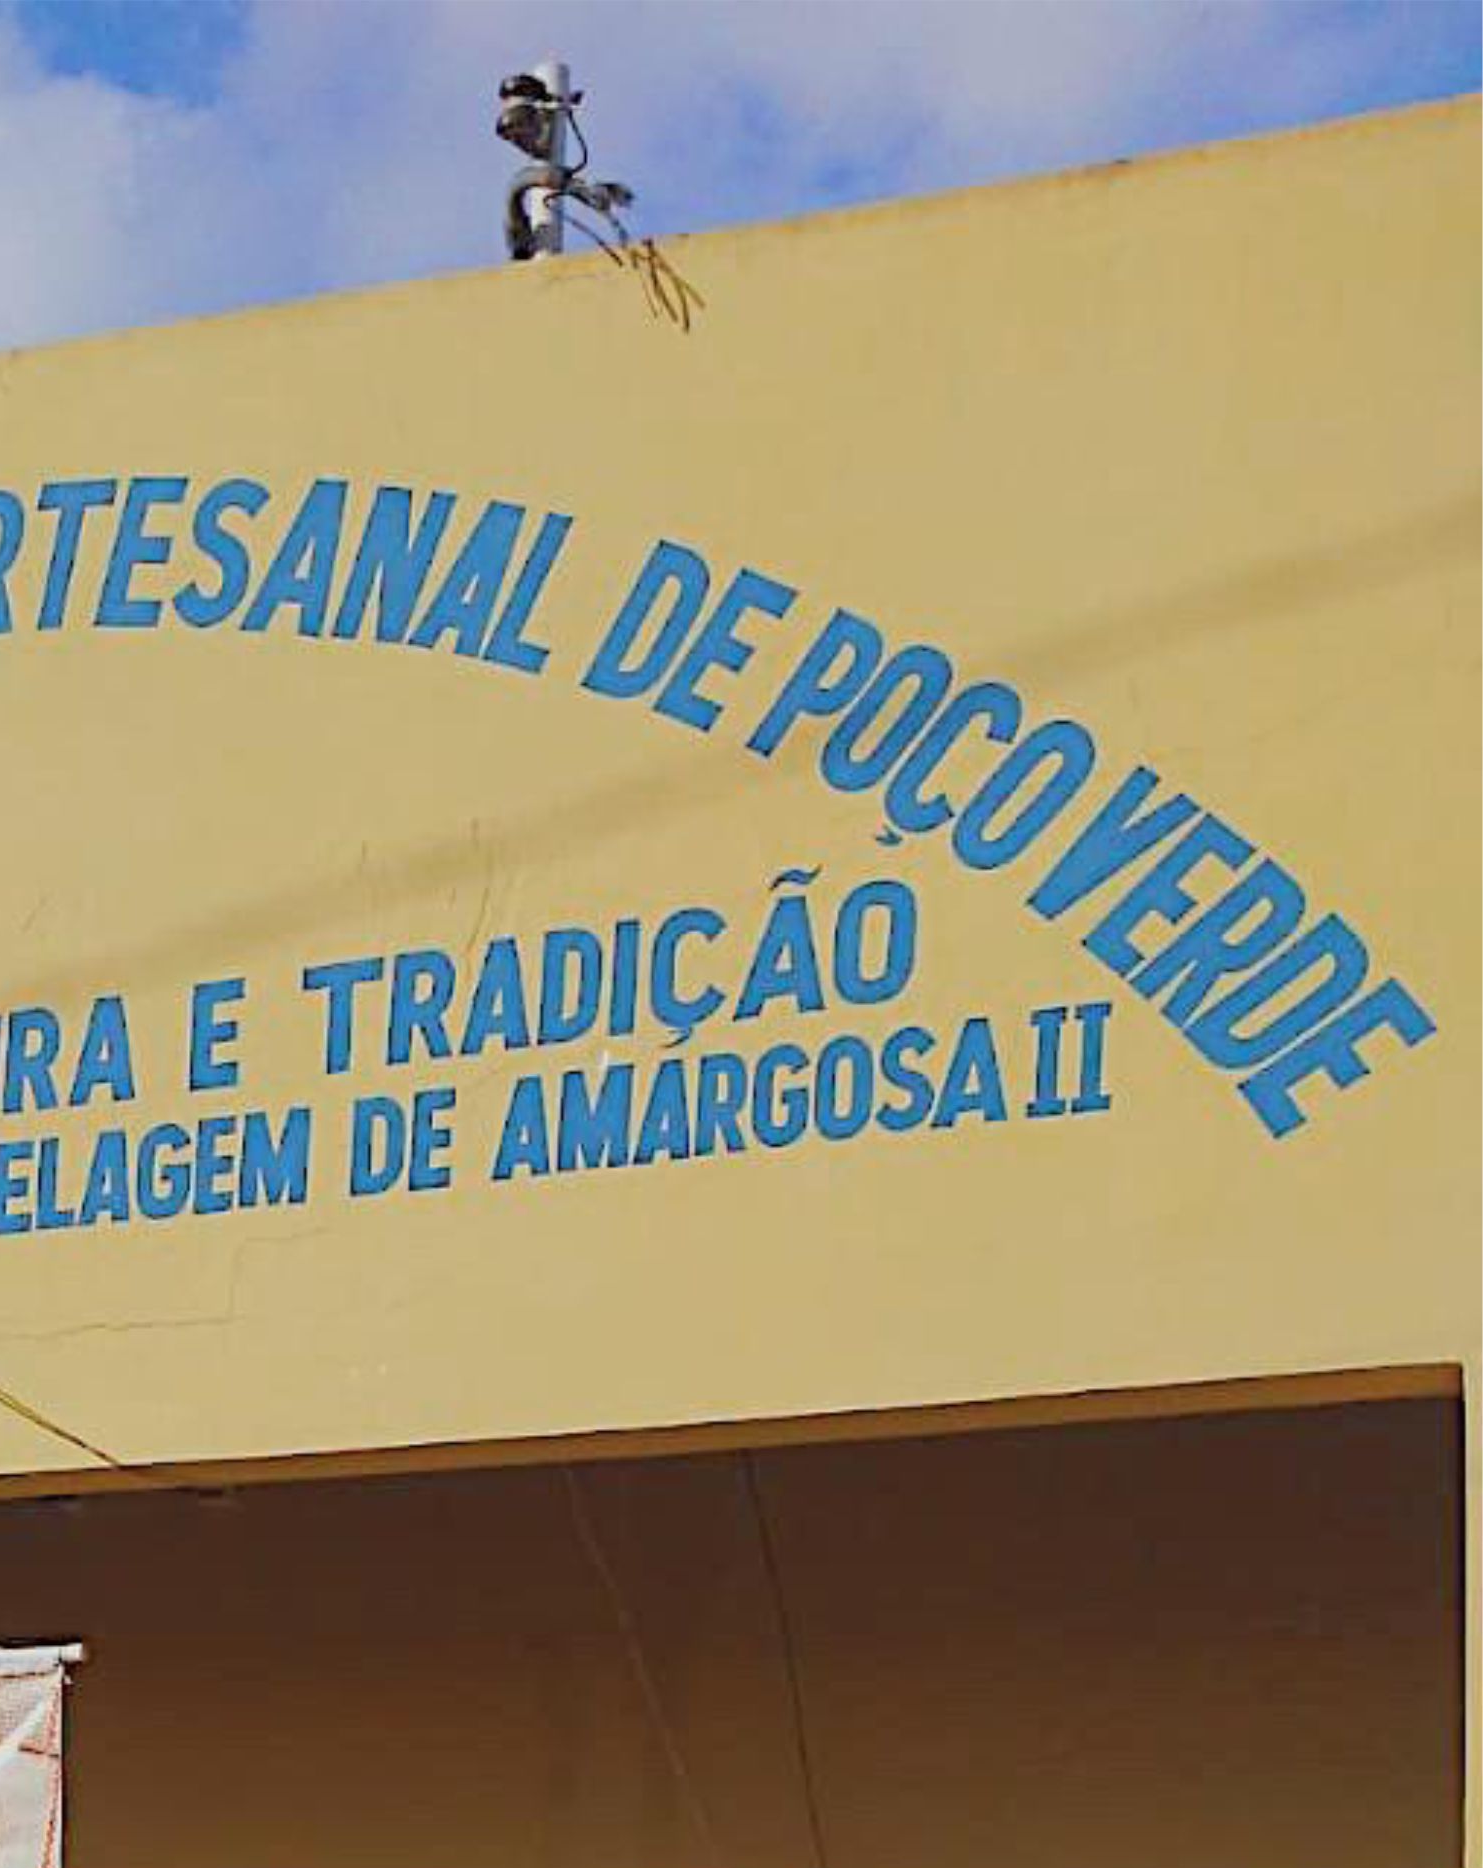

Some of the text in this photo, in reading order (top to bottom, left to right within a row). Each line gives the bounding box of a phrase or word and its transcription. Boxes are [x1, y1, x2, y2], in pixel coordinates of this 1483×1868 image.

[583, 540, 796, 732] DE
[746, 608, 1097, 872] POÇO
[1026, 766, 1437, 1140] VERDE
[187, 978, 246, 1091] E
[301, 866, 917, 1075] TRADIÇÃO
[348, 1087, 457, 1198] DE
[491, 1016, 1009, 1182] AMARGOSA
[1026, 1002, 1113, 1121] II
